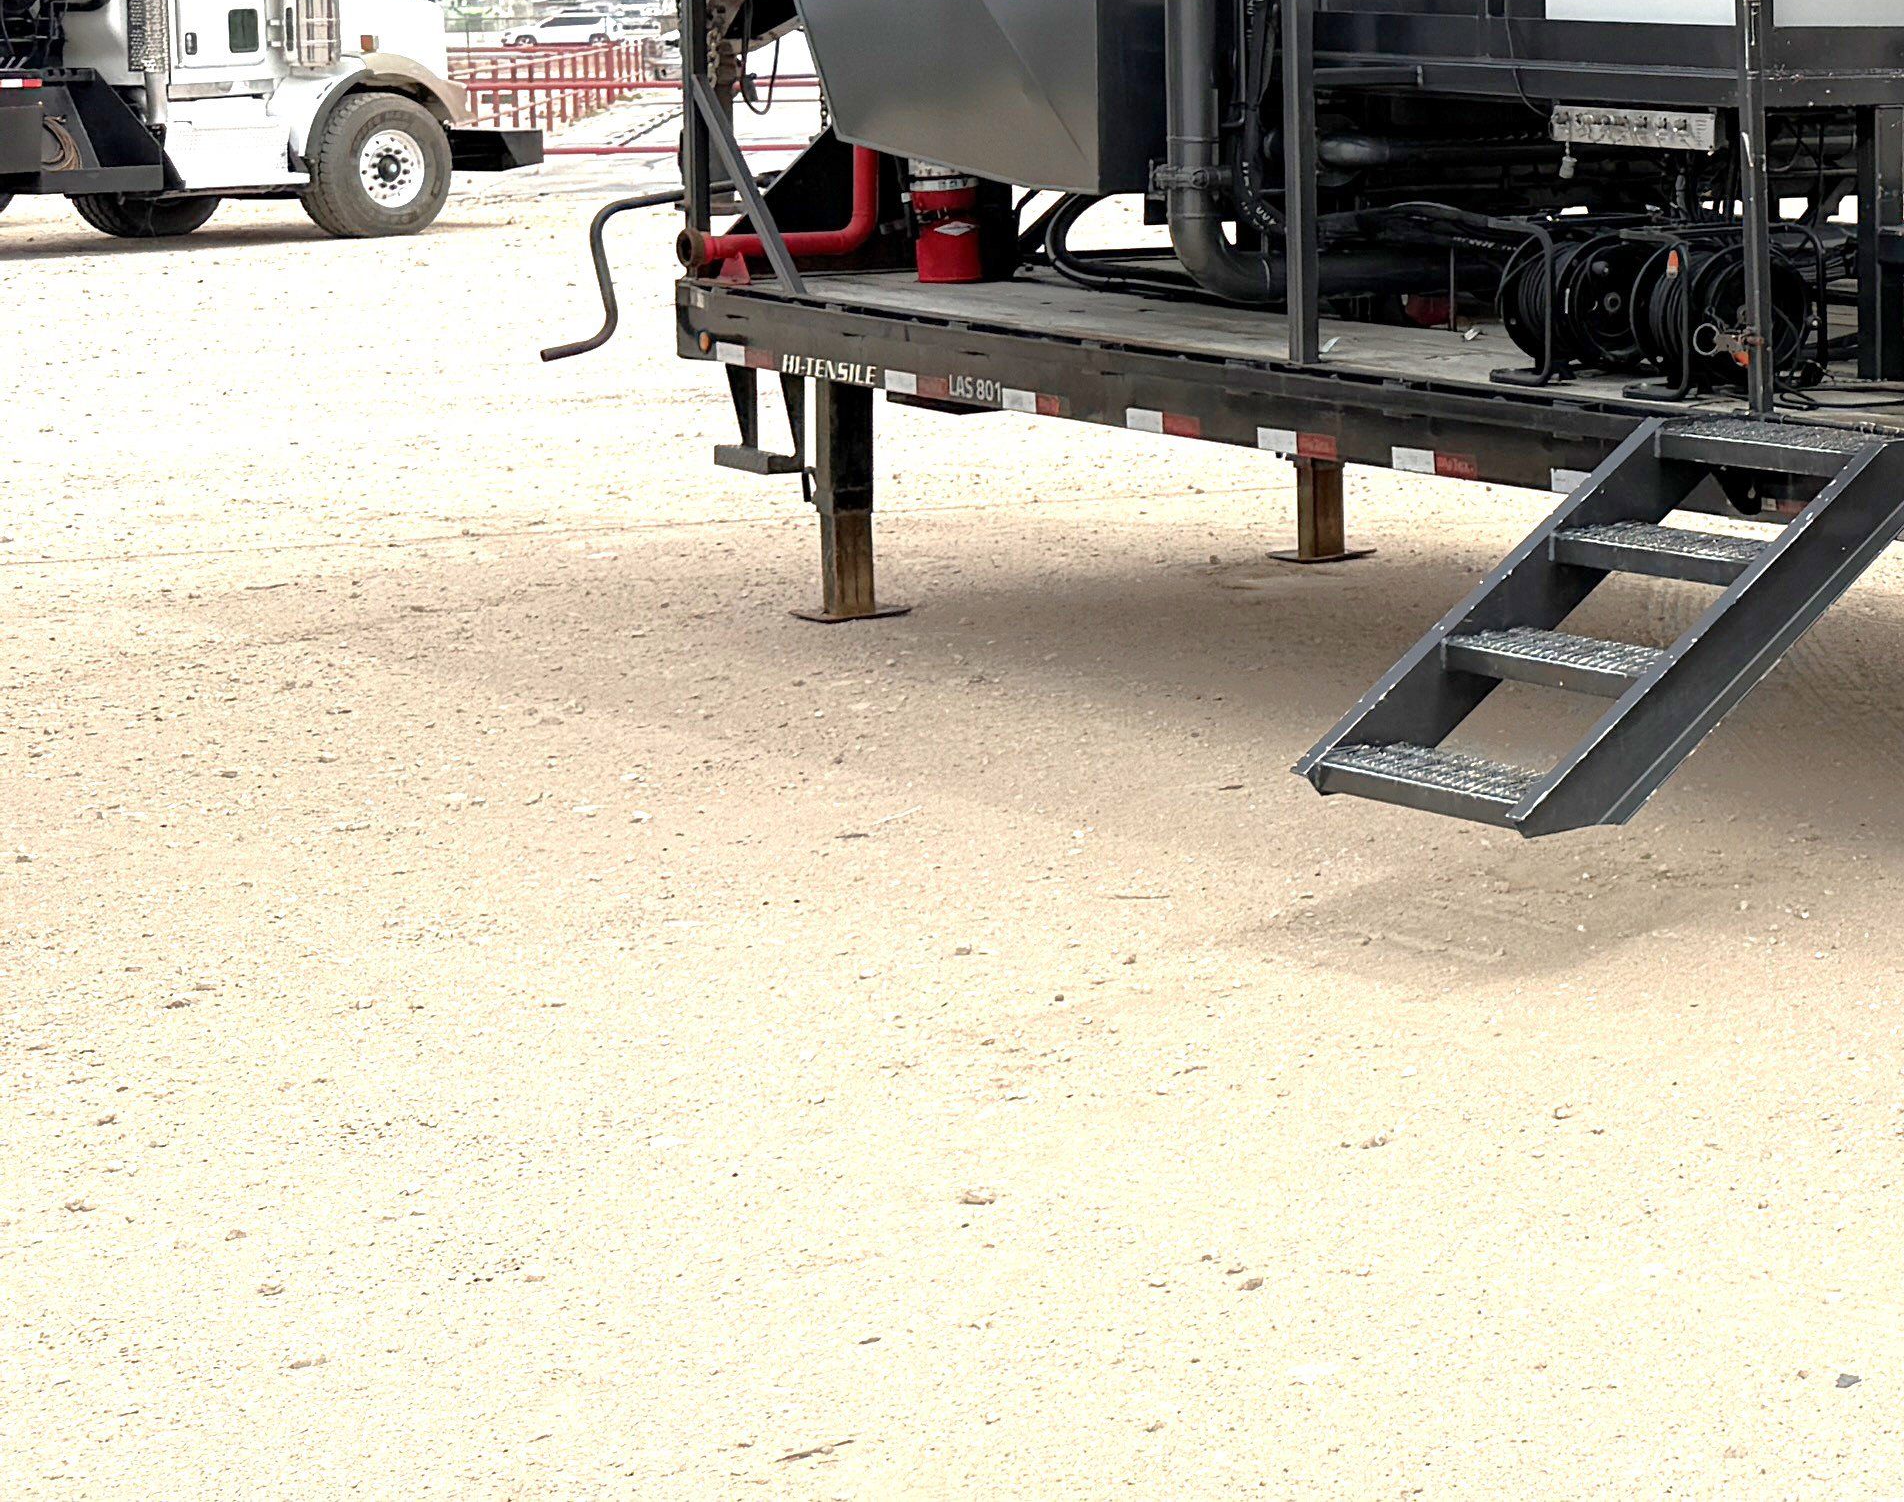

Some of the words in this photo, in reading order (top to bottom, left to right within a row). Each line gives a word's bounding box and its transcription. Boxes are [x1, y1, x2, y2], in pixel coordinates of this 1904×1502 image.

[782, 354, 877, 386] HI-TENSILE
[949, 374, 974, 399] LAS
[976, 378, 1002, 403] 801
